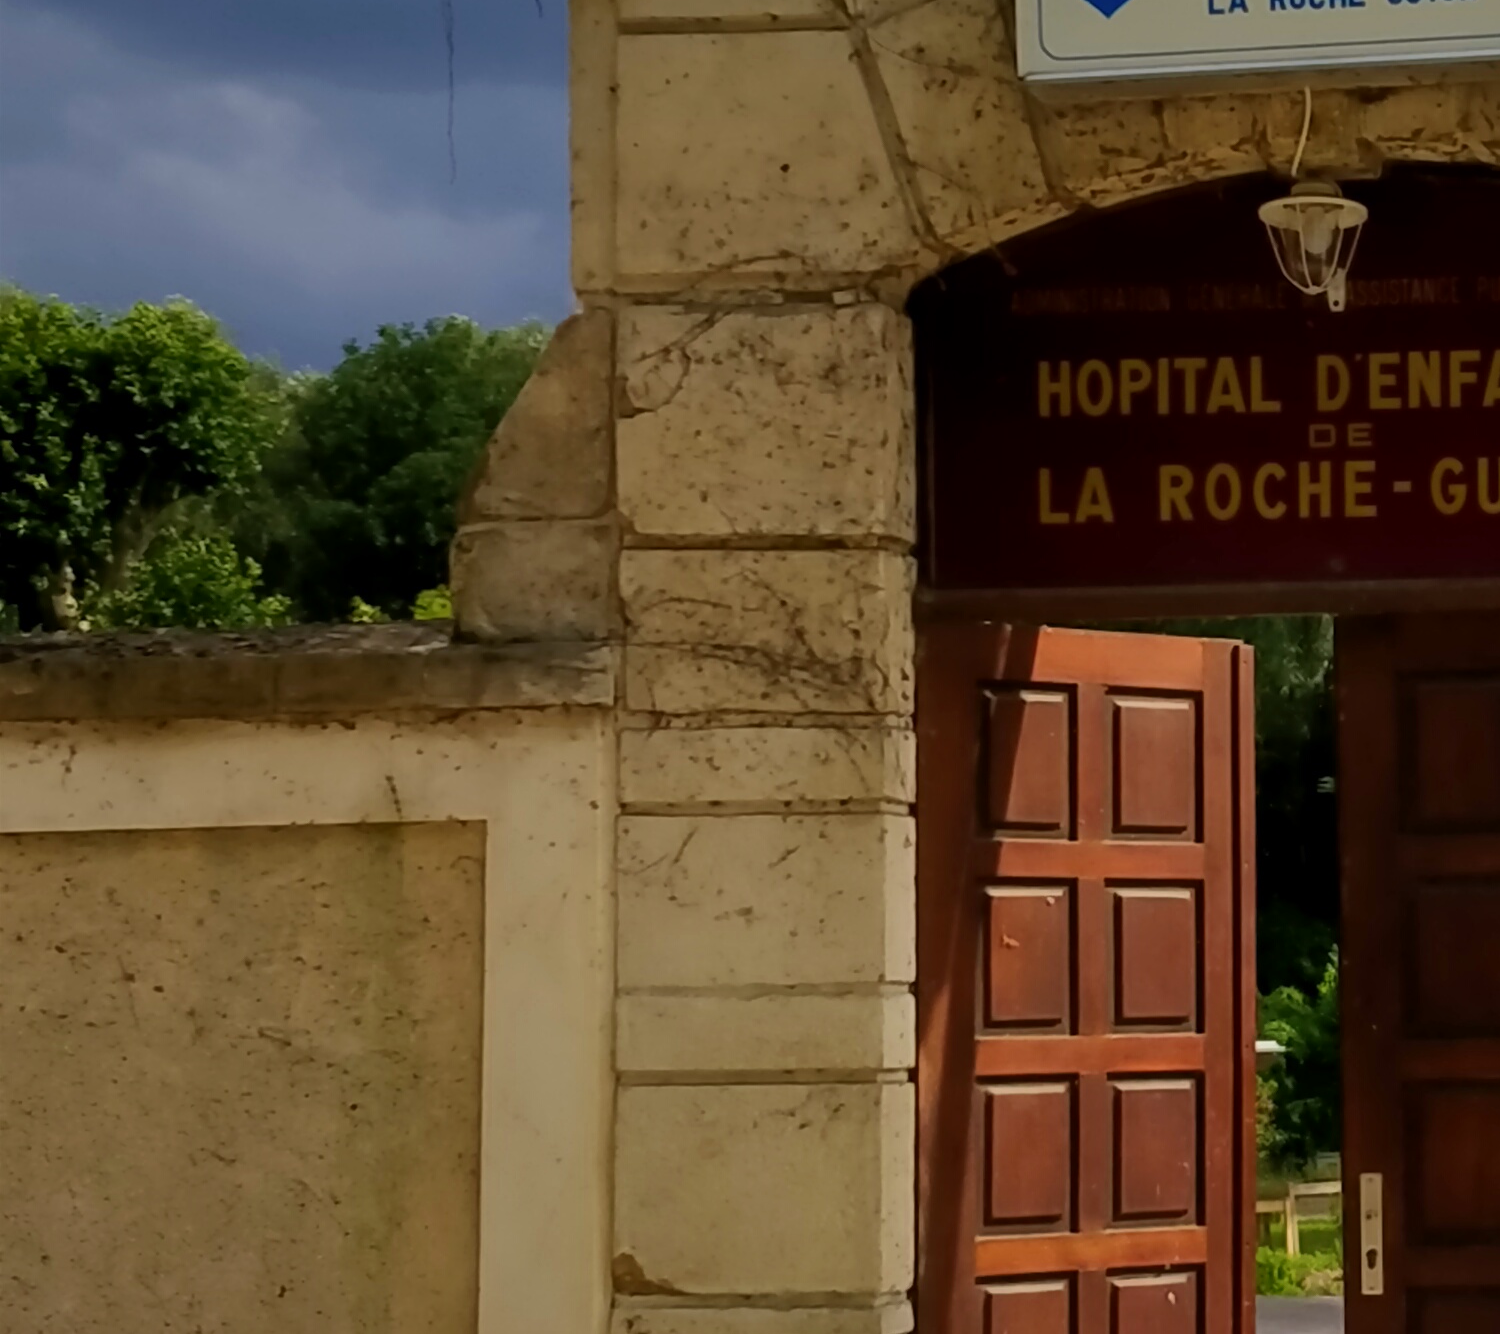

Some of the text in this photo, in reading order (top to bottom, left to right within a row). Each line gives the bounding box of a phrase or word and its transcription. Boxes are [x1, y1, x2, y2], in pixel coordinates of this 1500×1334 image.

[1037, 355, 1283, 418] HOPITAL
[1308, 423, 1375, 449] DE
[1037, 466, 1115, 526] LA
